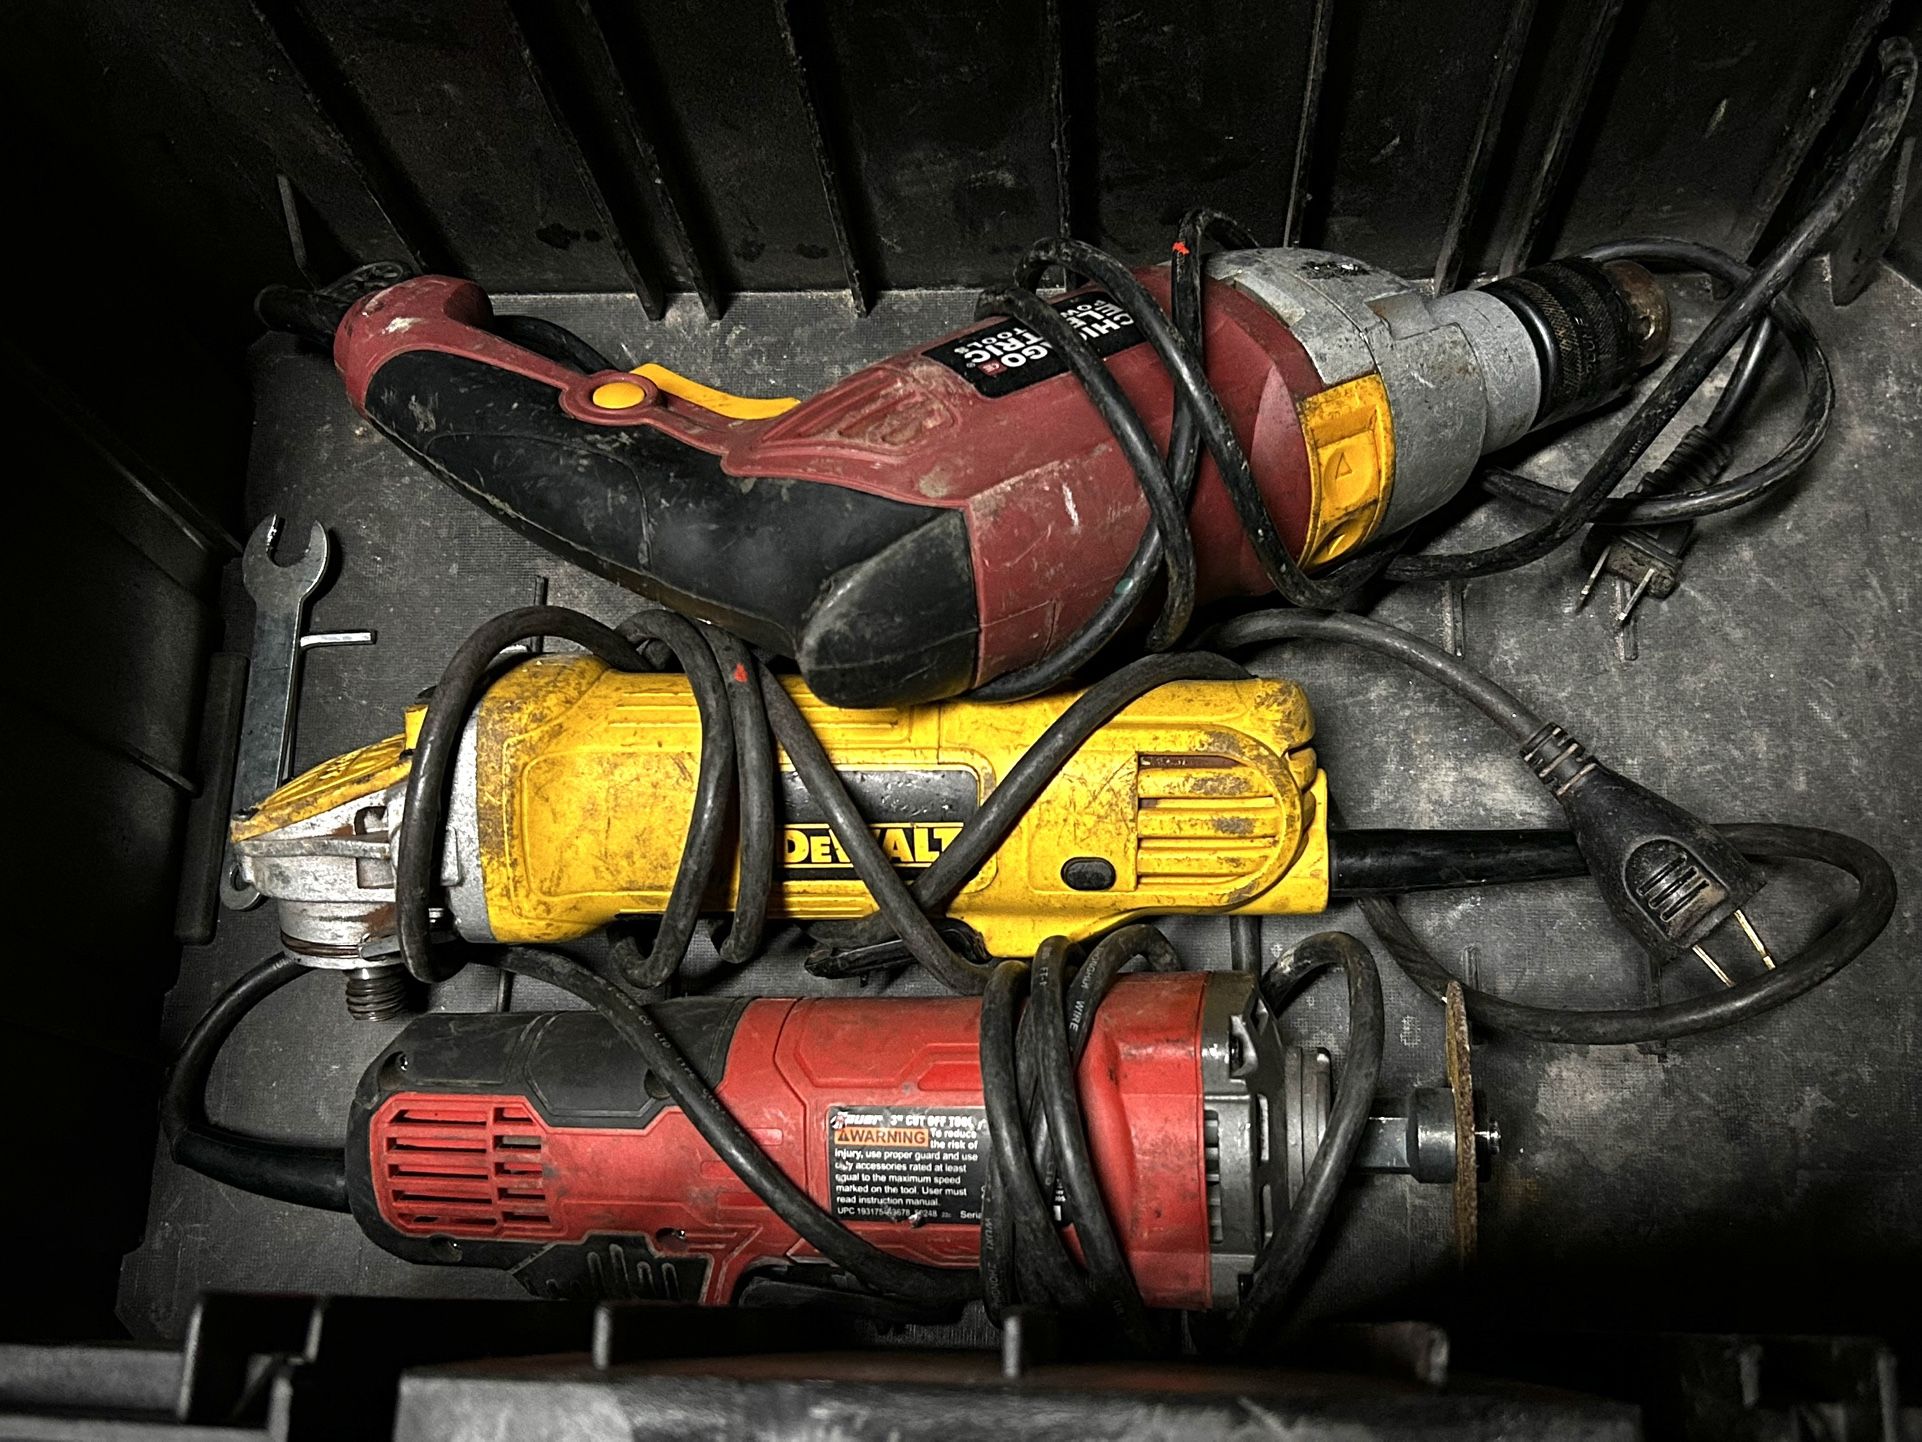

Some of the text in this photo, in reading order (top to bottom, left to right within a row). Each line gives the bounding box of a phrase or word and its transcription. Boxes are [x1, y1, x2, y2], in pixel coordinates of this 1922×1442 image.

[964, 301, 1123, 364] ELETRIC
[1001, 312, 1134, 368] CHIGO
[1069, 1000, 1086, 1032] WIRE
[905, 1115, 926, 1127] CUT
[928, 1116, 946, 1128] OFF
[849, 1128, 978, 1145] WARNING To reduce
[930, 1140, 978, 1150] the risk of
[865, 1151, 882, 1159] use
[884, 1151, 913, 1160] proper
[915, 1150, 940, 1161] guard
[943, 1150, 960, 1160] and
[962, 1153, 978, 1161] use
[855, 1162, 907, 1171] accessories
[909, 1162, 932, 1172] rated
[934, 1163, 943, 1172] at
[945, 1163, 967, 1173] least
[862, 1174, 870, 1182] to
[872, 1174, 886, 1182] the
[888, 1175, 931, 1184] maximum
[934, 1176, 961, 1186] speed
[836, 1184, 869, 1193] marked
[884, 1186, 898, 1194] the
[900, 1186, 919, 1194] tool.
[921, 1187, 943, 1195] User
[945, 1188, 967, 1196] must
[836, 1196, 940, 1206] read instruction manual.
[838, 1207, 855, 1215] UPC
[960, 1210, 982, 1220] Seria
[984, 1217, 993, 1250] WUXI
